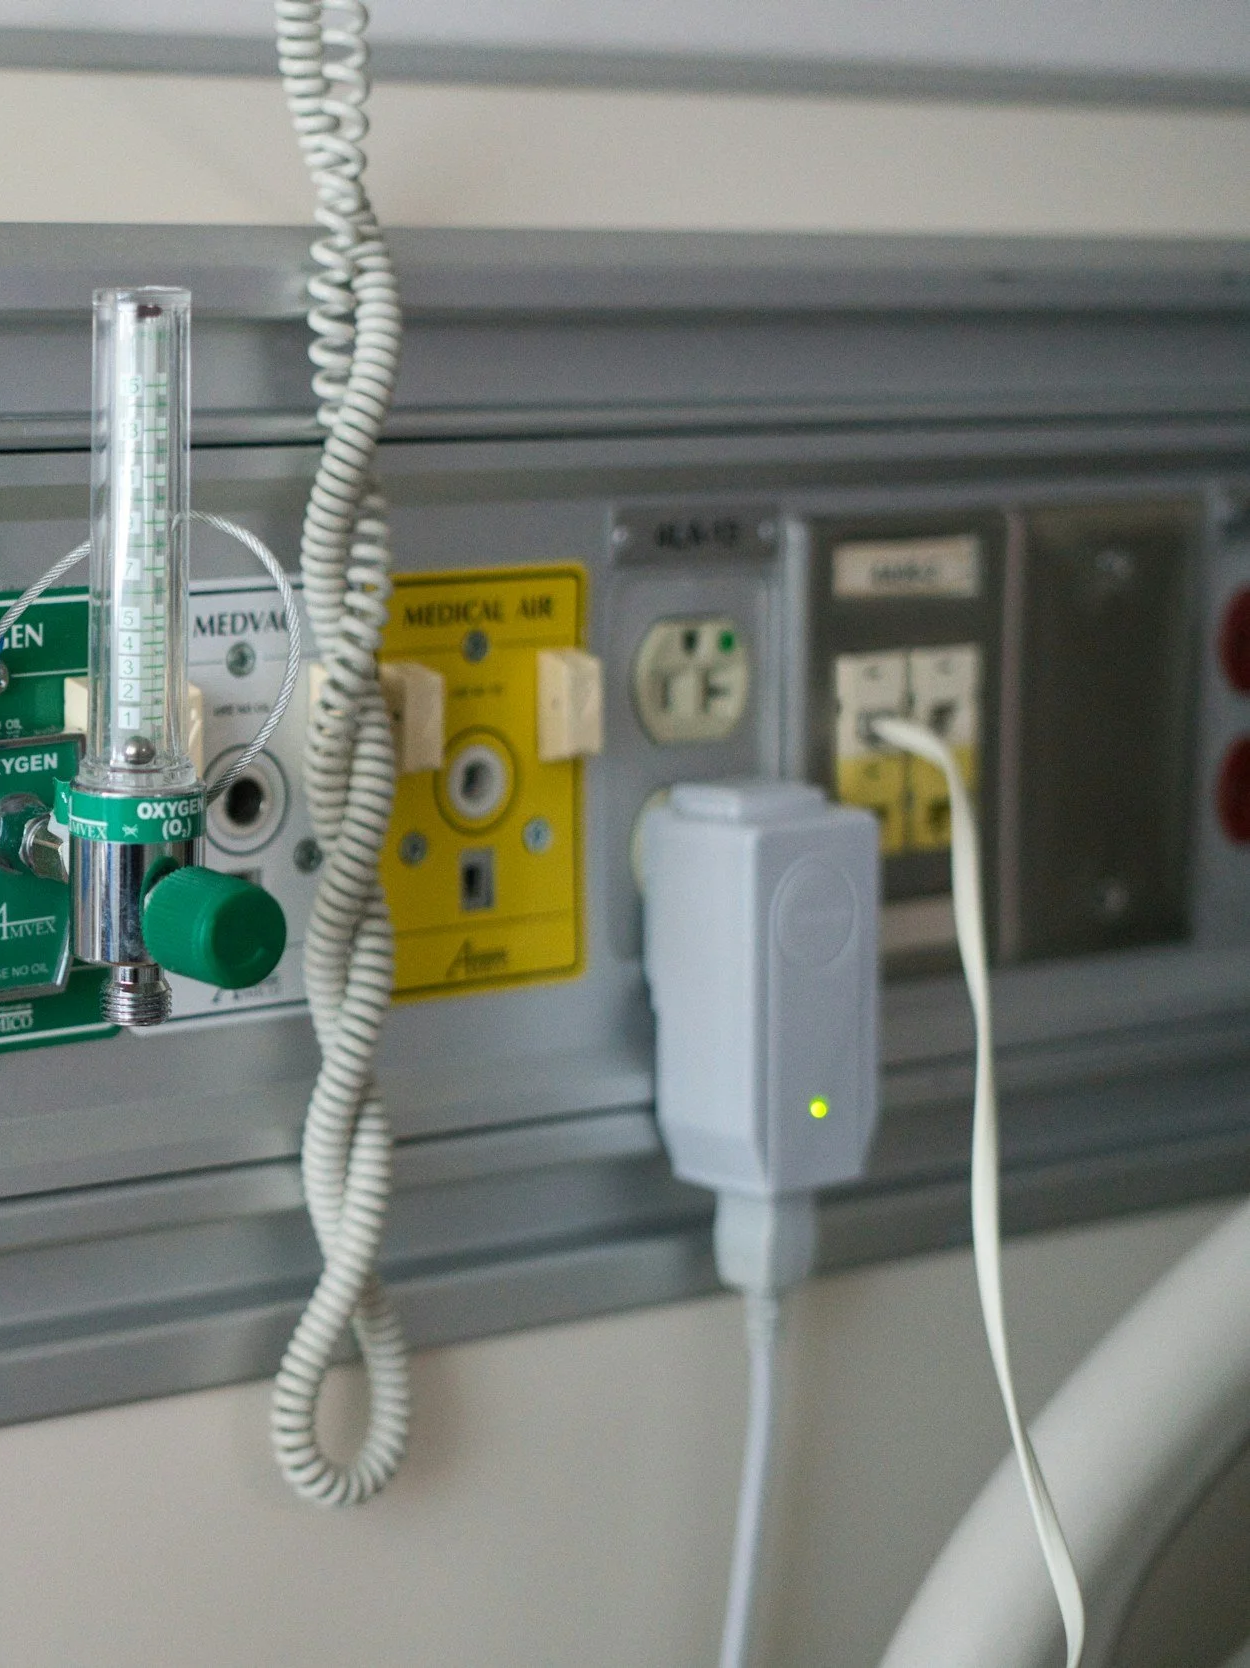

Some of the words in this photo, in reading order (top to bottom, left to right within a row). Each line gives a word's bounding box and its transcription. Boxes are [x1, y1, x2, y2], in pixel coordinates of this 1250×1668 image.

[122, 610, 134, 626] 5
[403, 602, 504, 627] MEDICAL
[517, 594, 554, 620] AIR
[122, 635, 133, 651] 4
[123, 659, 134, 675] 3
[123, 683, 134, 699] 2
[5, 718, 23, 730] OIL
[136, 797, 205, 820] OXYGEN
[12, 964, 29, 977] NO
[31, 962, 49, 974] OIL
